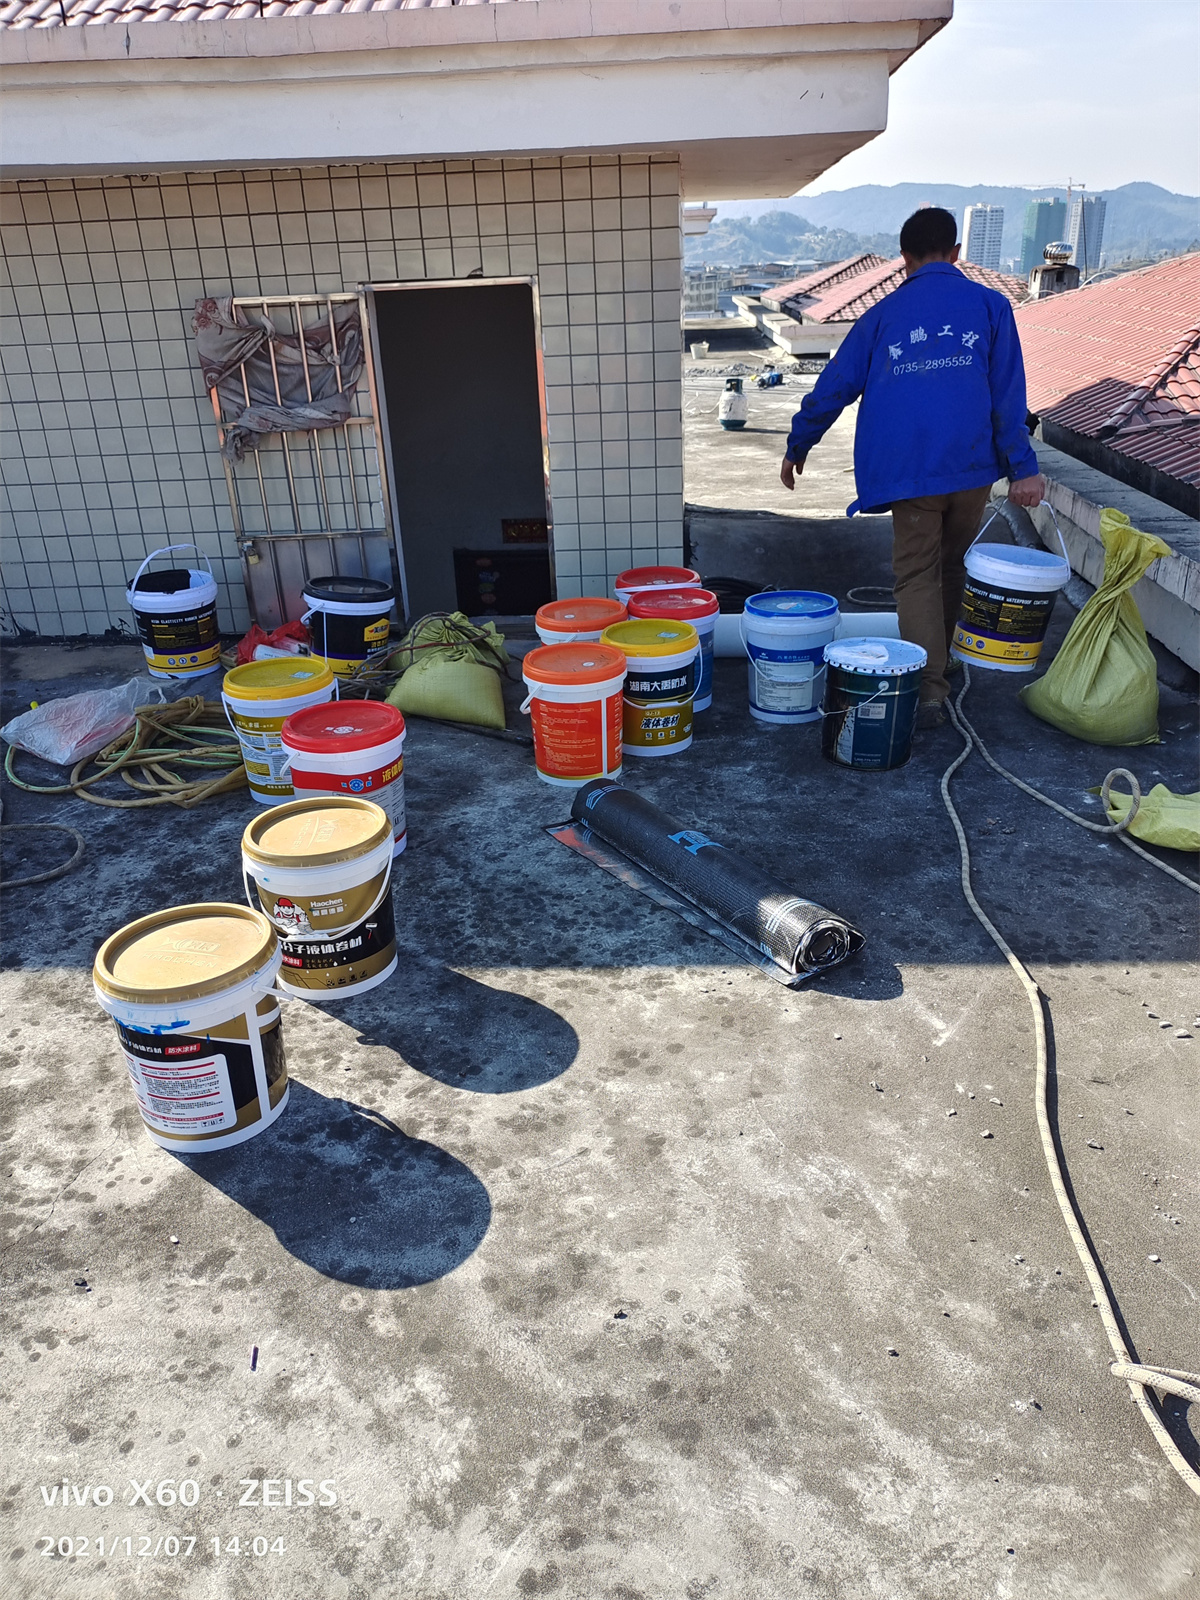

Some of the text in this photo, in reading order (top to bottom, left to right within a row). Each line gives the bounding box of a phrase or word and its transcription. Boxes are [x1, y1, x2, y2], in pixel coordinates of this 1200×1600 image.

[893, 355, 972, 376] 0735-2895552
[629, 675, 687, 692] 湖南大禹防水
[640, 713, 680, 729] 液体卷材
[310, 898, 343, 908] Haochen
[281, 936, 363, 955] 分子液体卷材
[282, 956, 300, 966] 水涂料
[168, 1045, 197, 1054] 防水涂料
